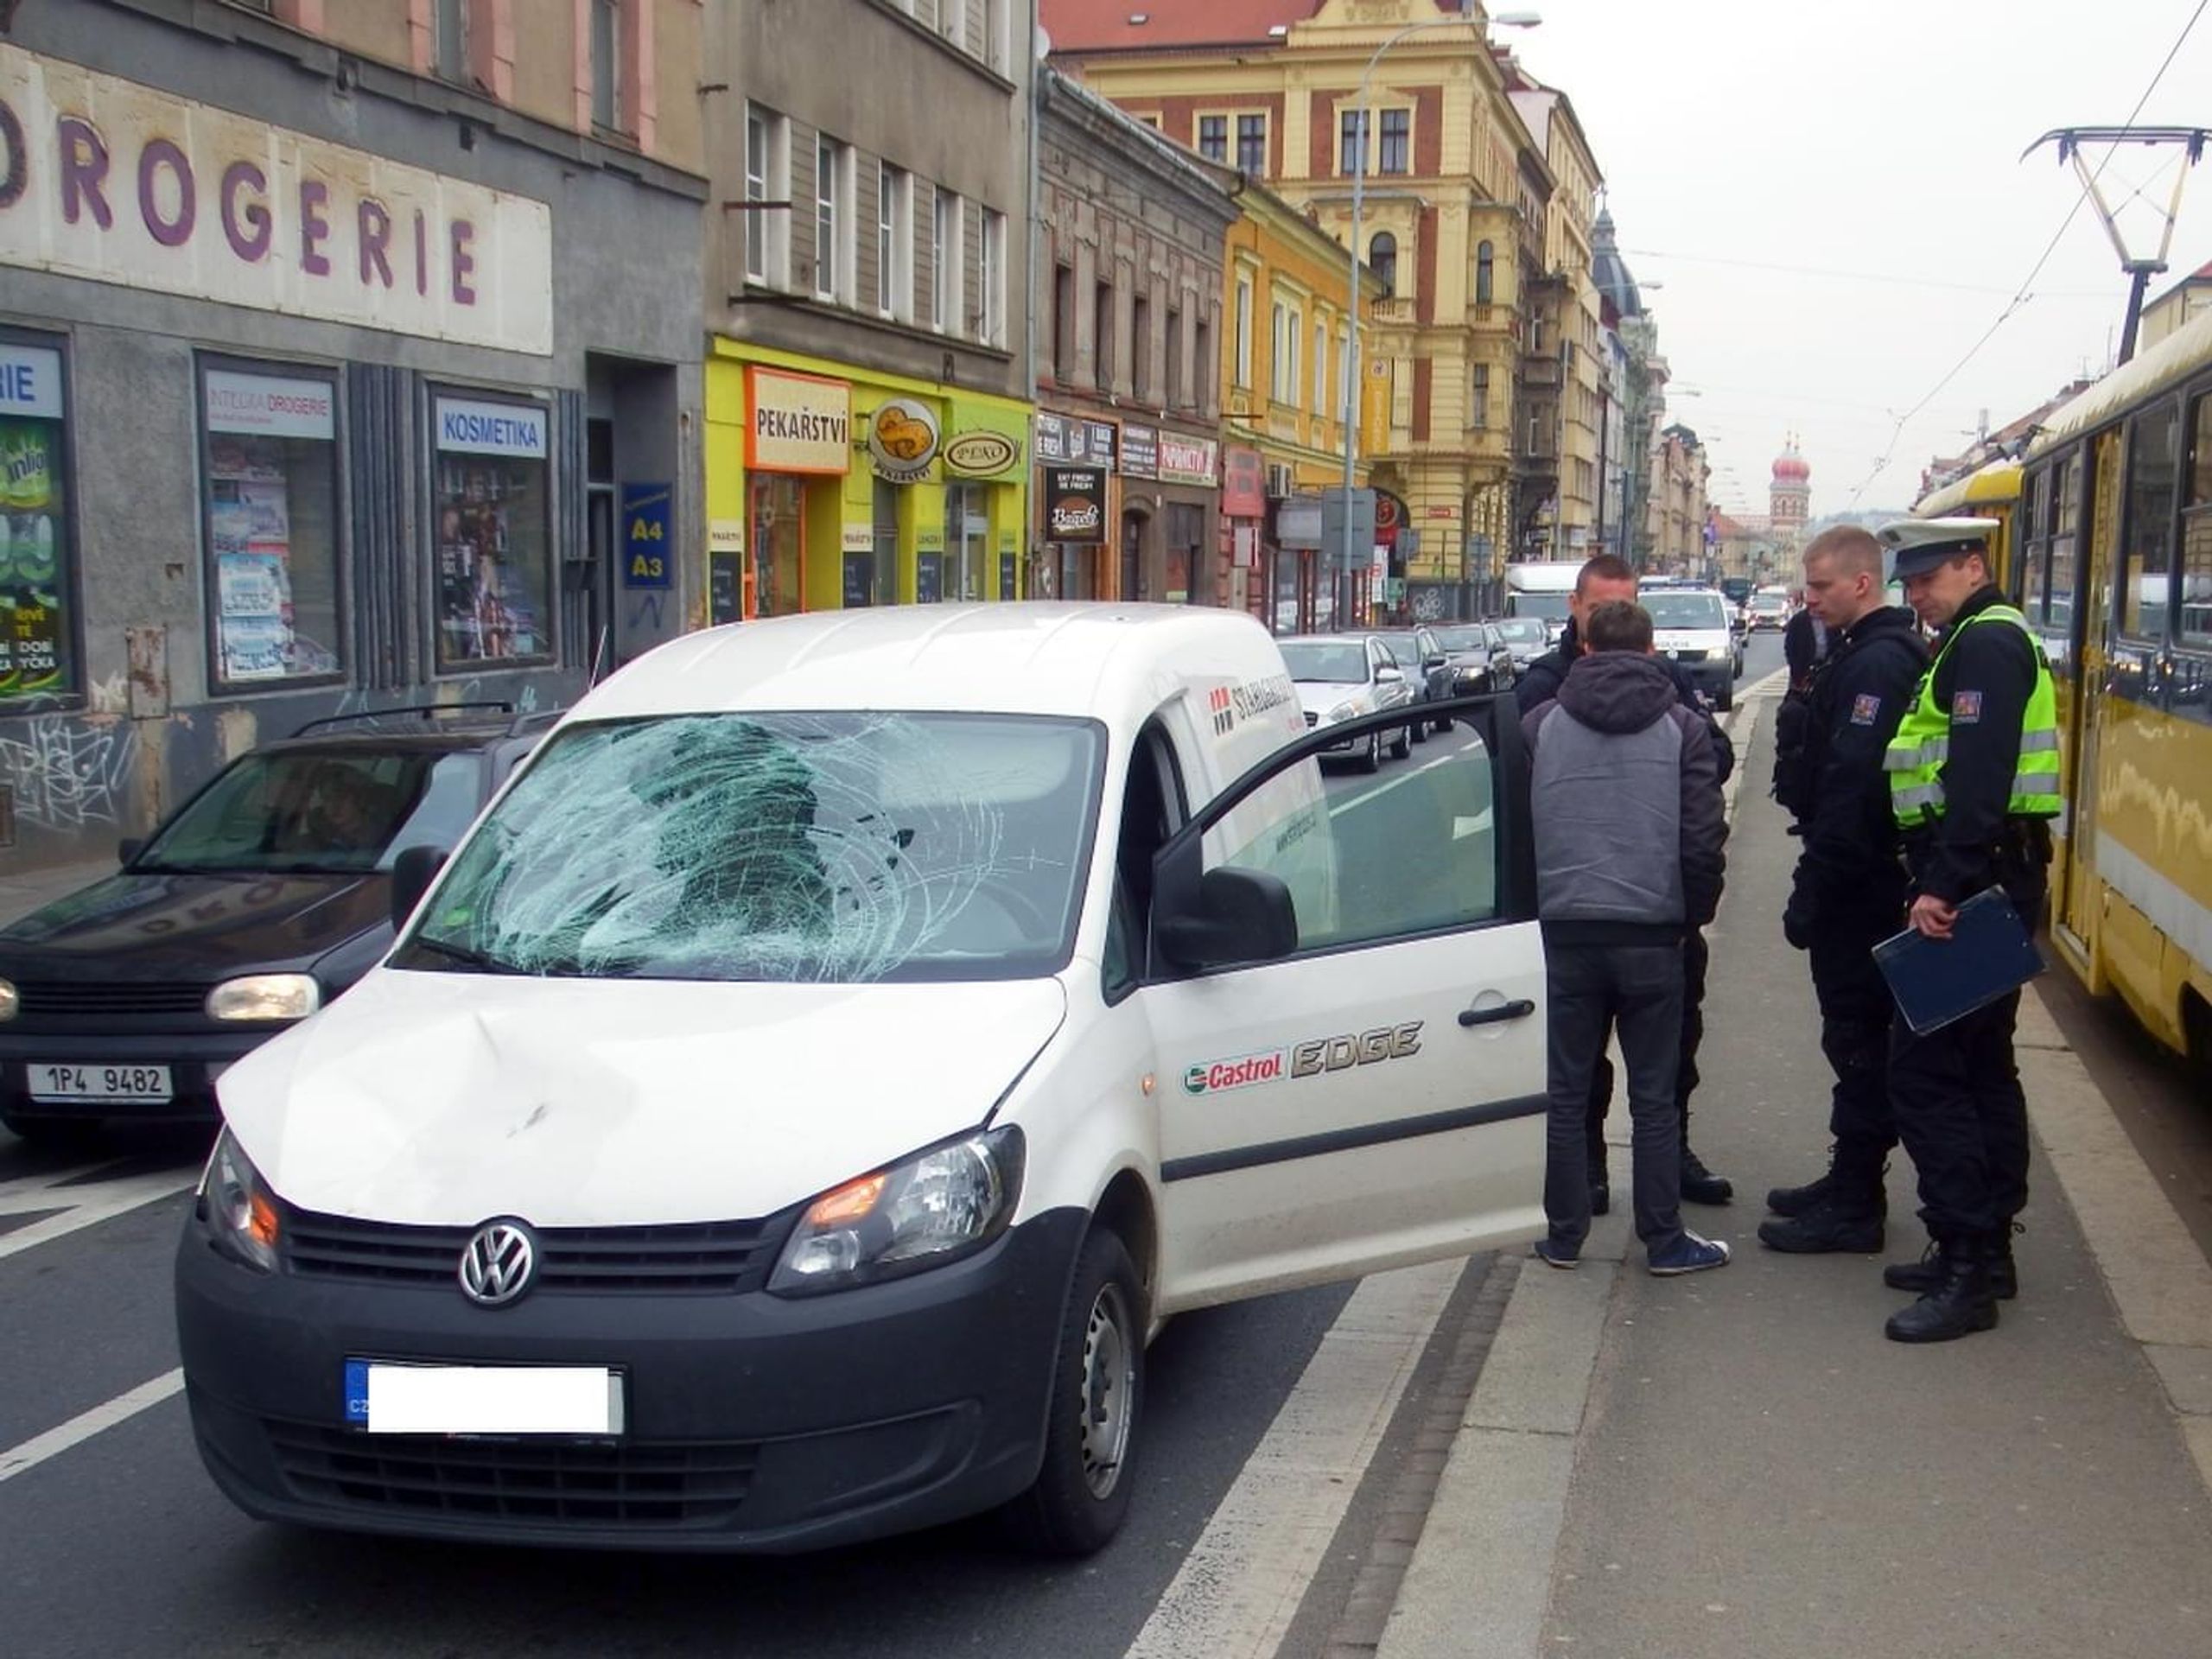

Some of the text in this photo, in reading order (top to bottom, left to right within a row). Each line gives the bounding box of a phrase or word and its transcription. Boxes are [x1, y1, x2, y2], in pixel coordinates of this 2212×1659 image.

[444, 413, 539, 448] KOSMETIKA
[757, 406, 846, 443] PEKAŘSTVÍ
[632, 518, 663, 541] A4
[632, 554, 663, 577] A3
[1210, 1020, 1425, 1089] Castrol EDGE
[48, 1068, 162, 1092] 1P4 9482
